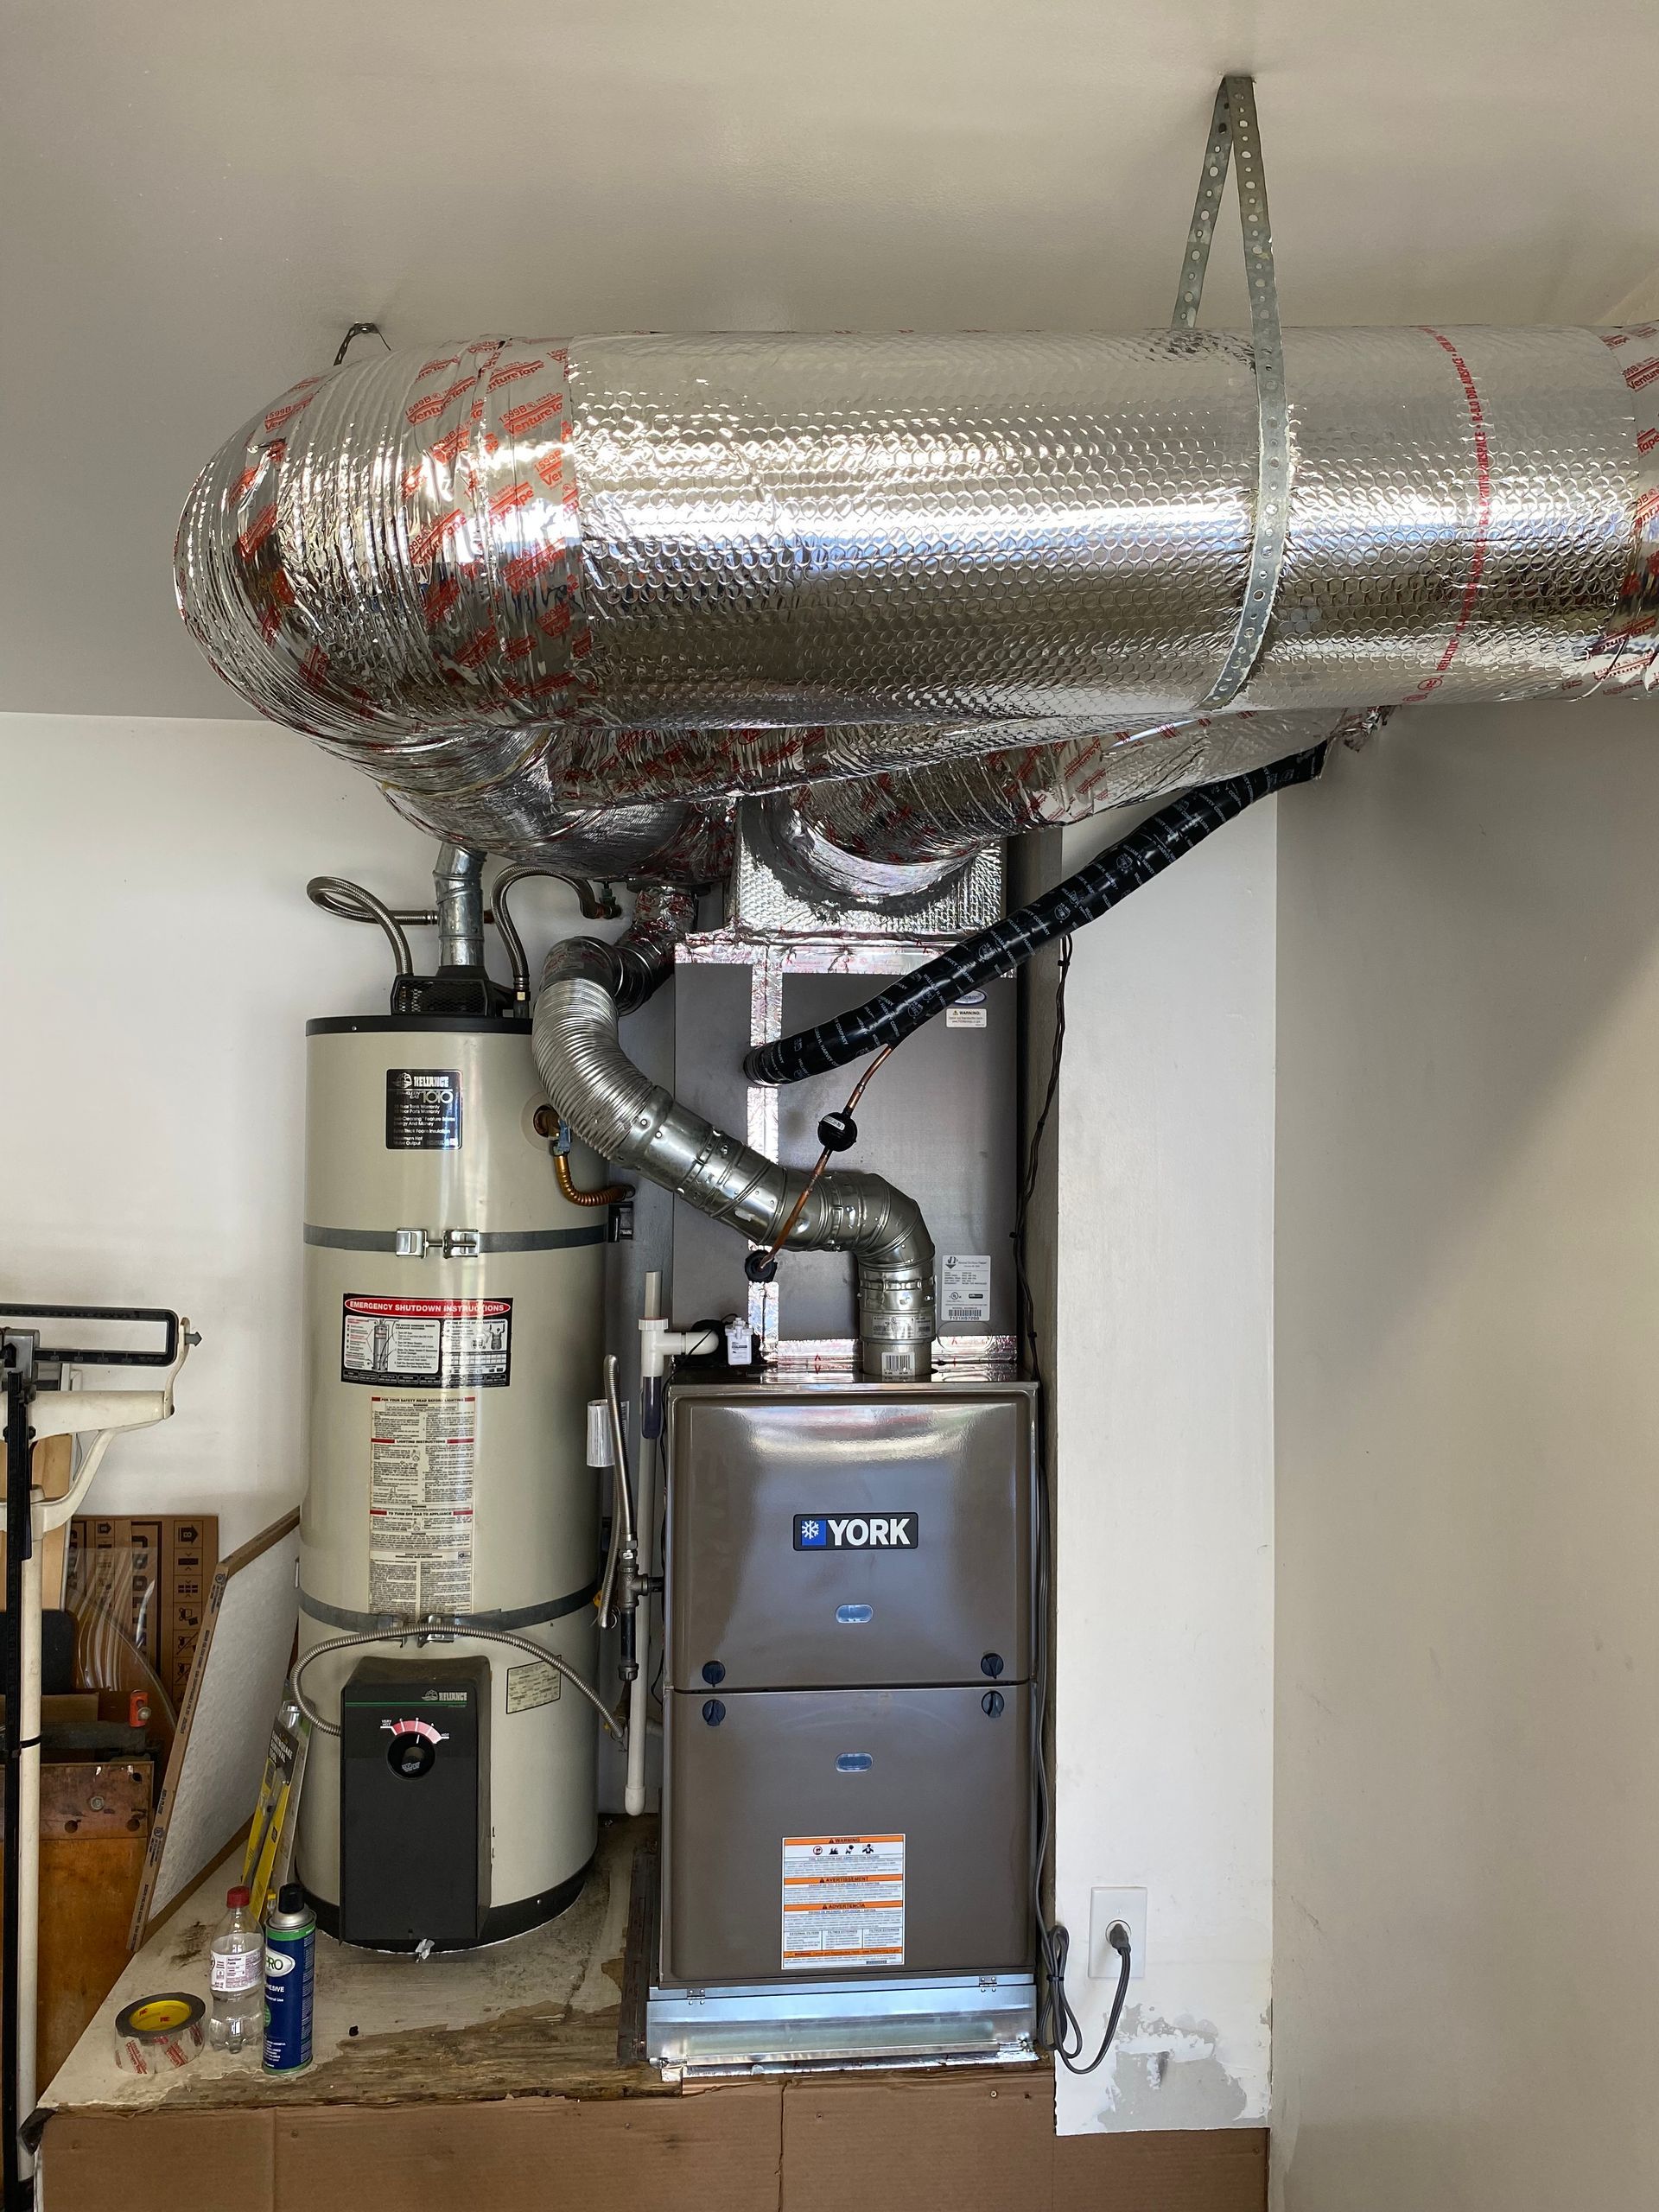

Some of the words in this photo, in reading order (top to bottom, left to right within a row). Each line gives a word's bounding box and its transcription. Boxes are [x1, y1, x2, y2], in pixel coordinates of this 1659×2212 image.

[1452, 358, 1473, 385] AIRSPACE
[405, 396, 432, 416] 1599B
[499, 405, 527, 423] 1599B
[836, 1023, 849, 1046] COMPANY
[414, 1077, 449, 1087] RELIANCE
[350, 1301, 393, 1311] EMERGENCY
[395, 1304, 441, 1312] SHUTDOWN
[828, 1518, 911, 1546] YORK
[439, 1692, 467, 1700] RELIANCE
